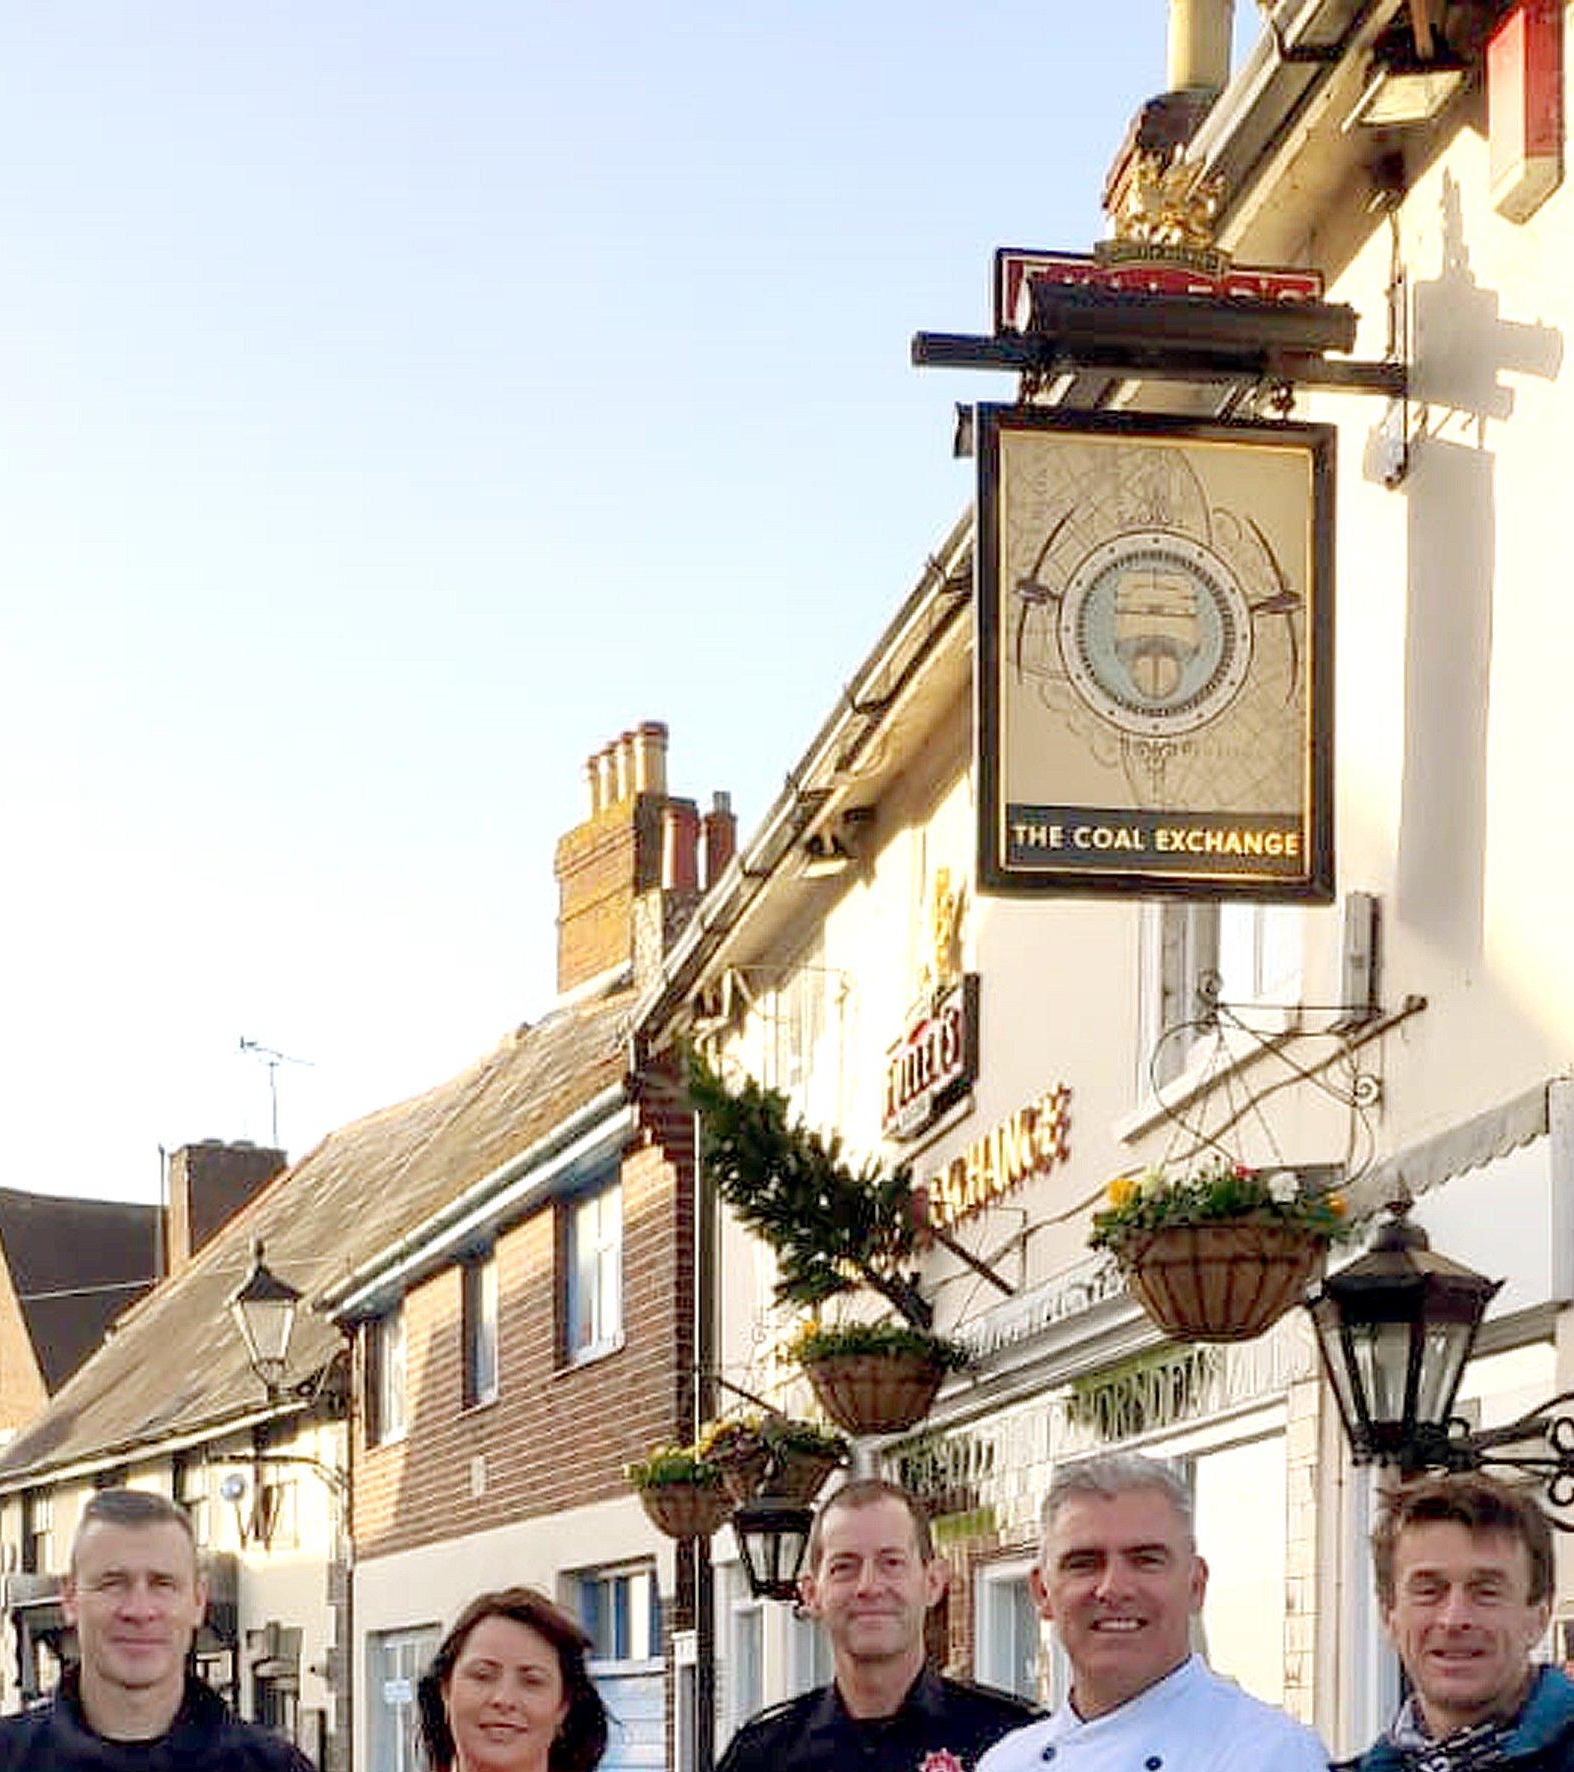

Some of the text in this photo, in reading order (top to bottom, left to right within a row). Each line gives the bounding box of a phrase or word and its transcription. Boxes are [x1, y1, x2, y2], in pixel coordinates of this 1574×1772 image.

[1013, 825, 1300, 856] THE COAL EXCHANGE
